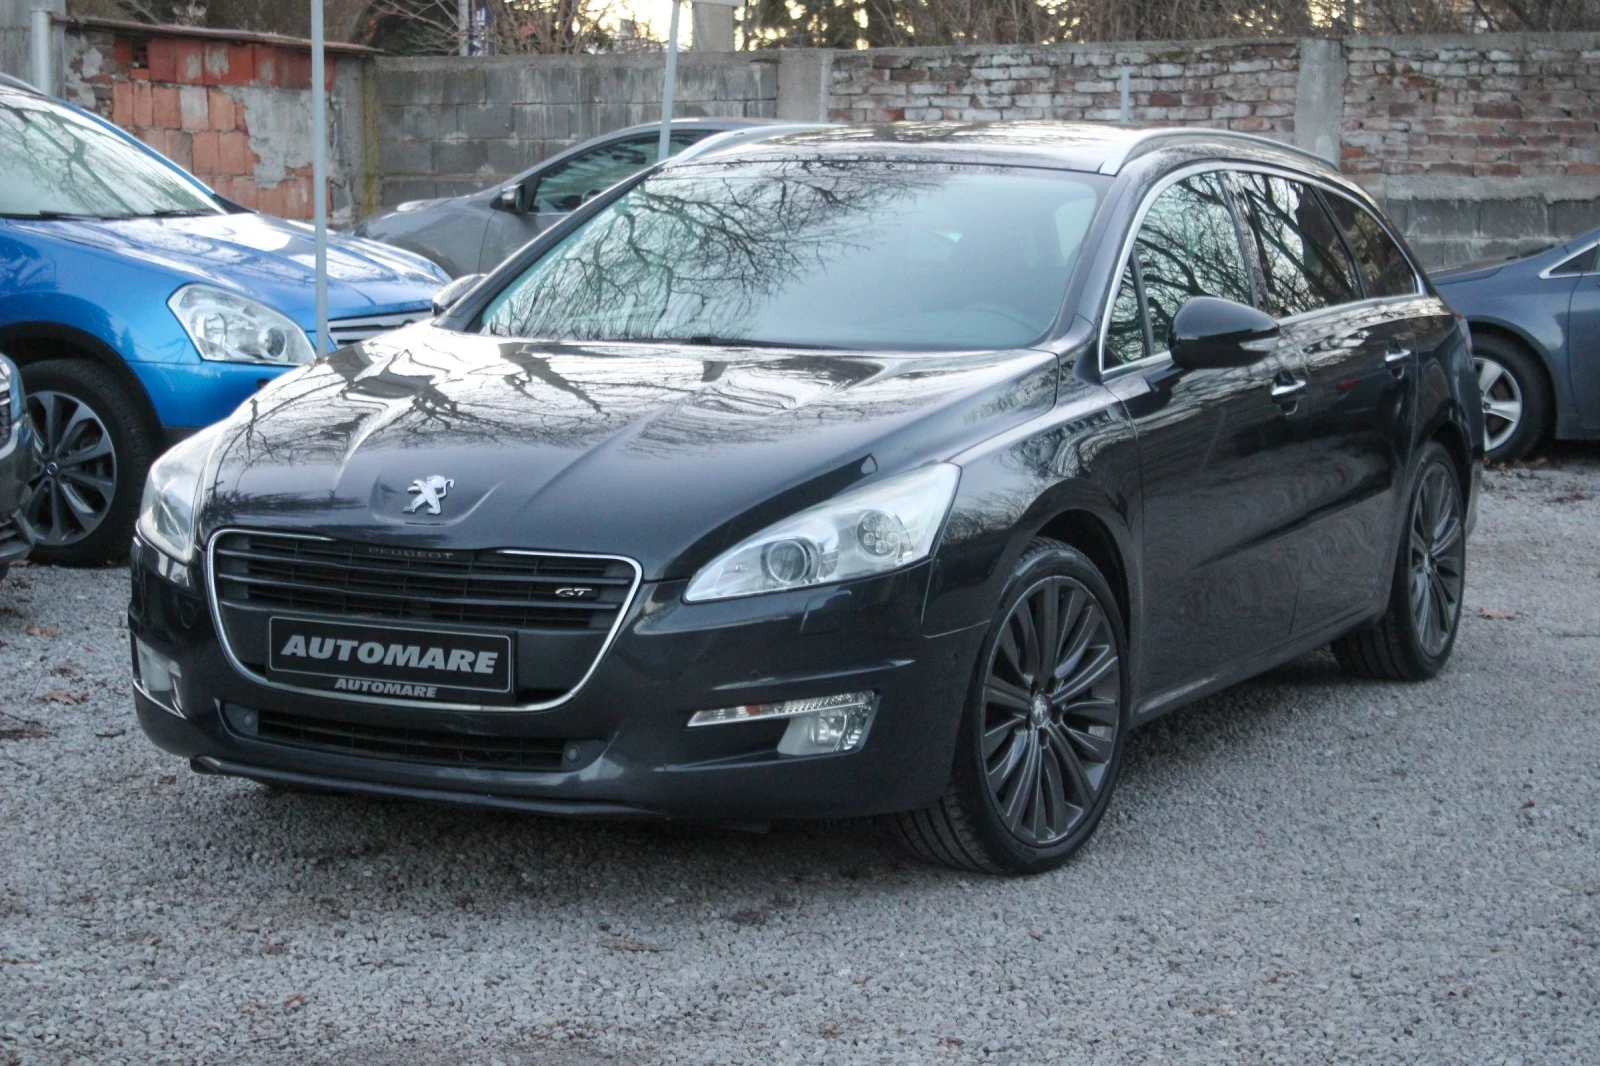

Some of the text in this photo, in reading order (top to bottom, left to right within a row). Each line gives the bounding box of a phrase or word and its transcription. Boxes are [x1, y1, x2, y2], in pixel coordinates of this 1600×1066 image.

[368, 547, 453, 559] PEUGEOT
[555, 588, 592, 598] GT
[281, 635, 498, 674] AUTOMARE
[334, 678, 438, 698] AUTOMARE
